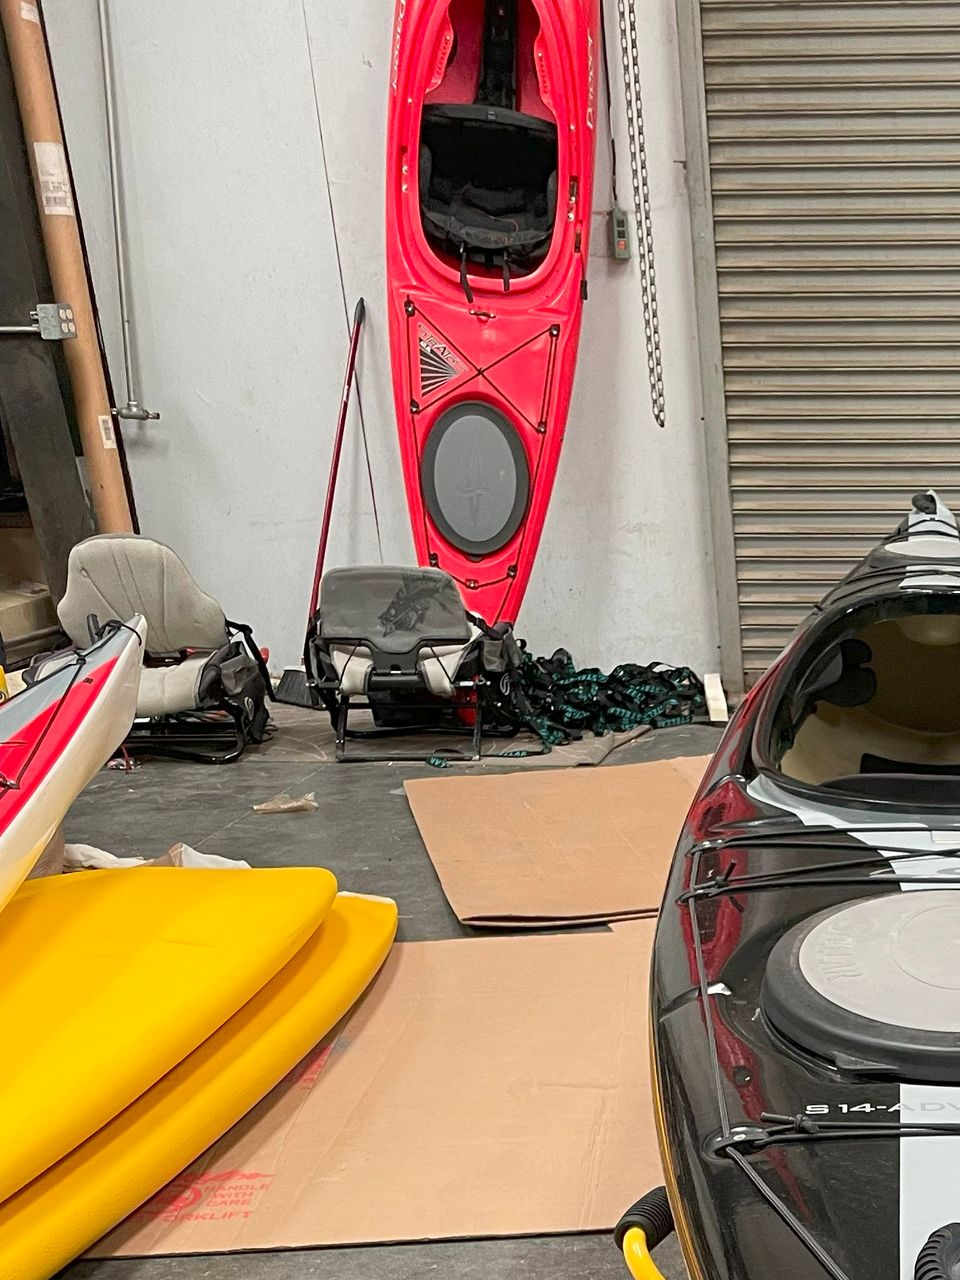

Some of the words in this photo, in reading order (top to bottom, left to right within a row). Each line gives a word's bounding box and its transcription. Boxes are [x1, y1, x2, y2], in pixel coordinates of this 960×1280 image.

[204, 1183, 271, 1193] HANDLE
[212, 1191, 254, 1199] WITH
[206, 1200, 251, 1208] CARE
